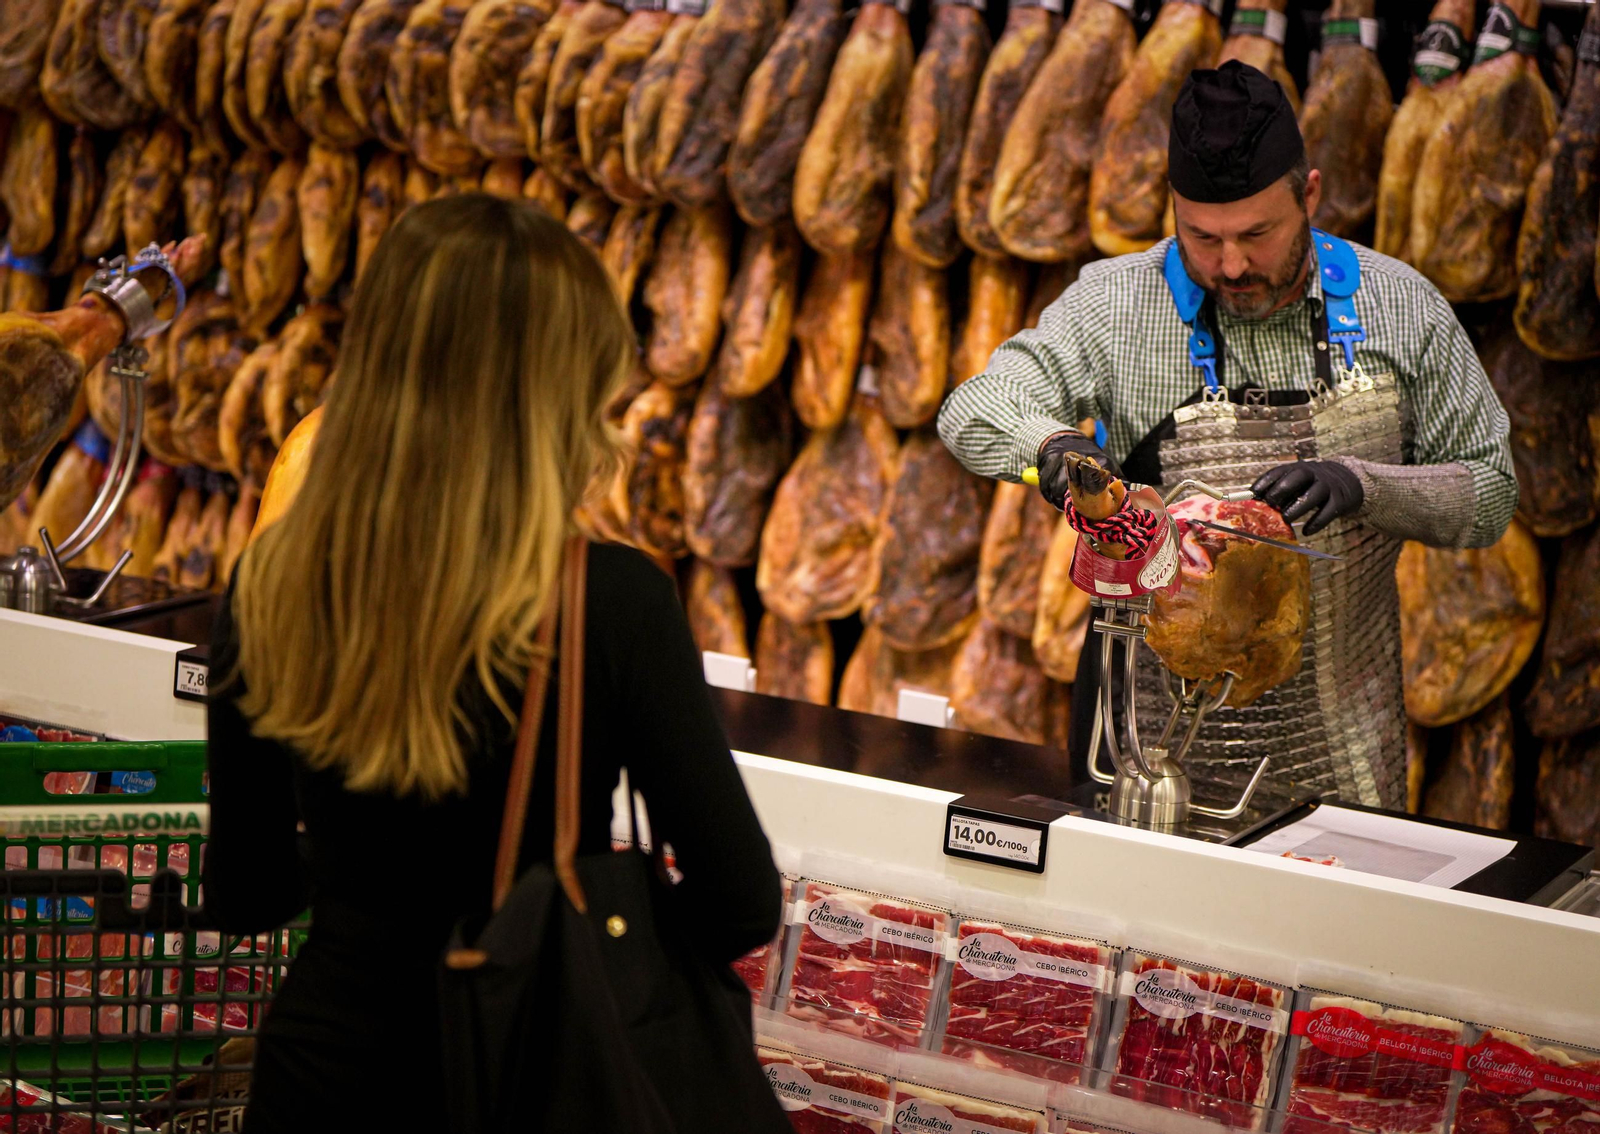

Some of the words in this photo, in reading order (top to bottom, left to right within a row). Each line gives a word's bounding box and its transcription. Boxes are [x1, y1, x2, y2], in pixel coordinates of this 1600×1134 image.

[19, 812, 201, 834] MERCADONA
[820, 922, 863, 936] MERCADONA
[882, 927, 903, 937] CEBO
[904, 931, 934, 944] IBÉRICO
[972, 958, 1016, 972] MERCADONA
[1035, 961, 1057, 972] CEBO
[1058, 966, 1088, 978] IBÉRICO
[1148, 994, 1195, 1011] MERCADONA
[1215, 1002, 1238, 1013] CEBO
[1320, 1033, 1369, 1050] MERCADONA
[1380, 1037, 1417, 1053] BELLOTA
[1481, 1069, 1532, 1086] MERCADONA
[1544, 1073, 1584, 1089] BELLOTA
[828, 1093, 849, 1104] CEBO
